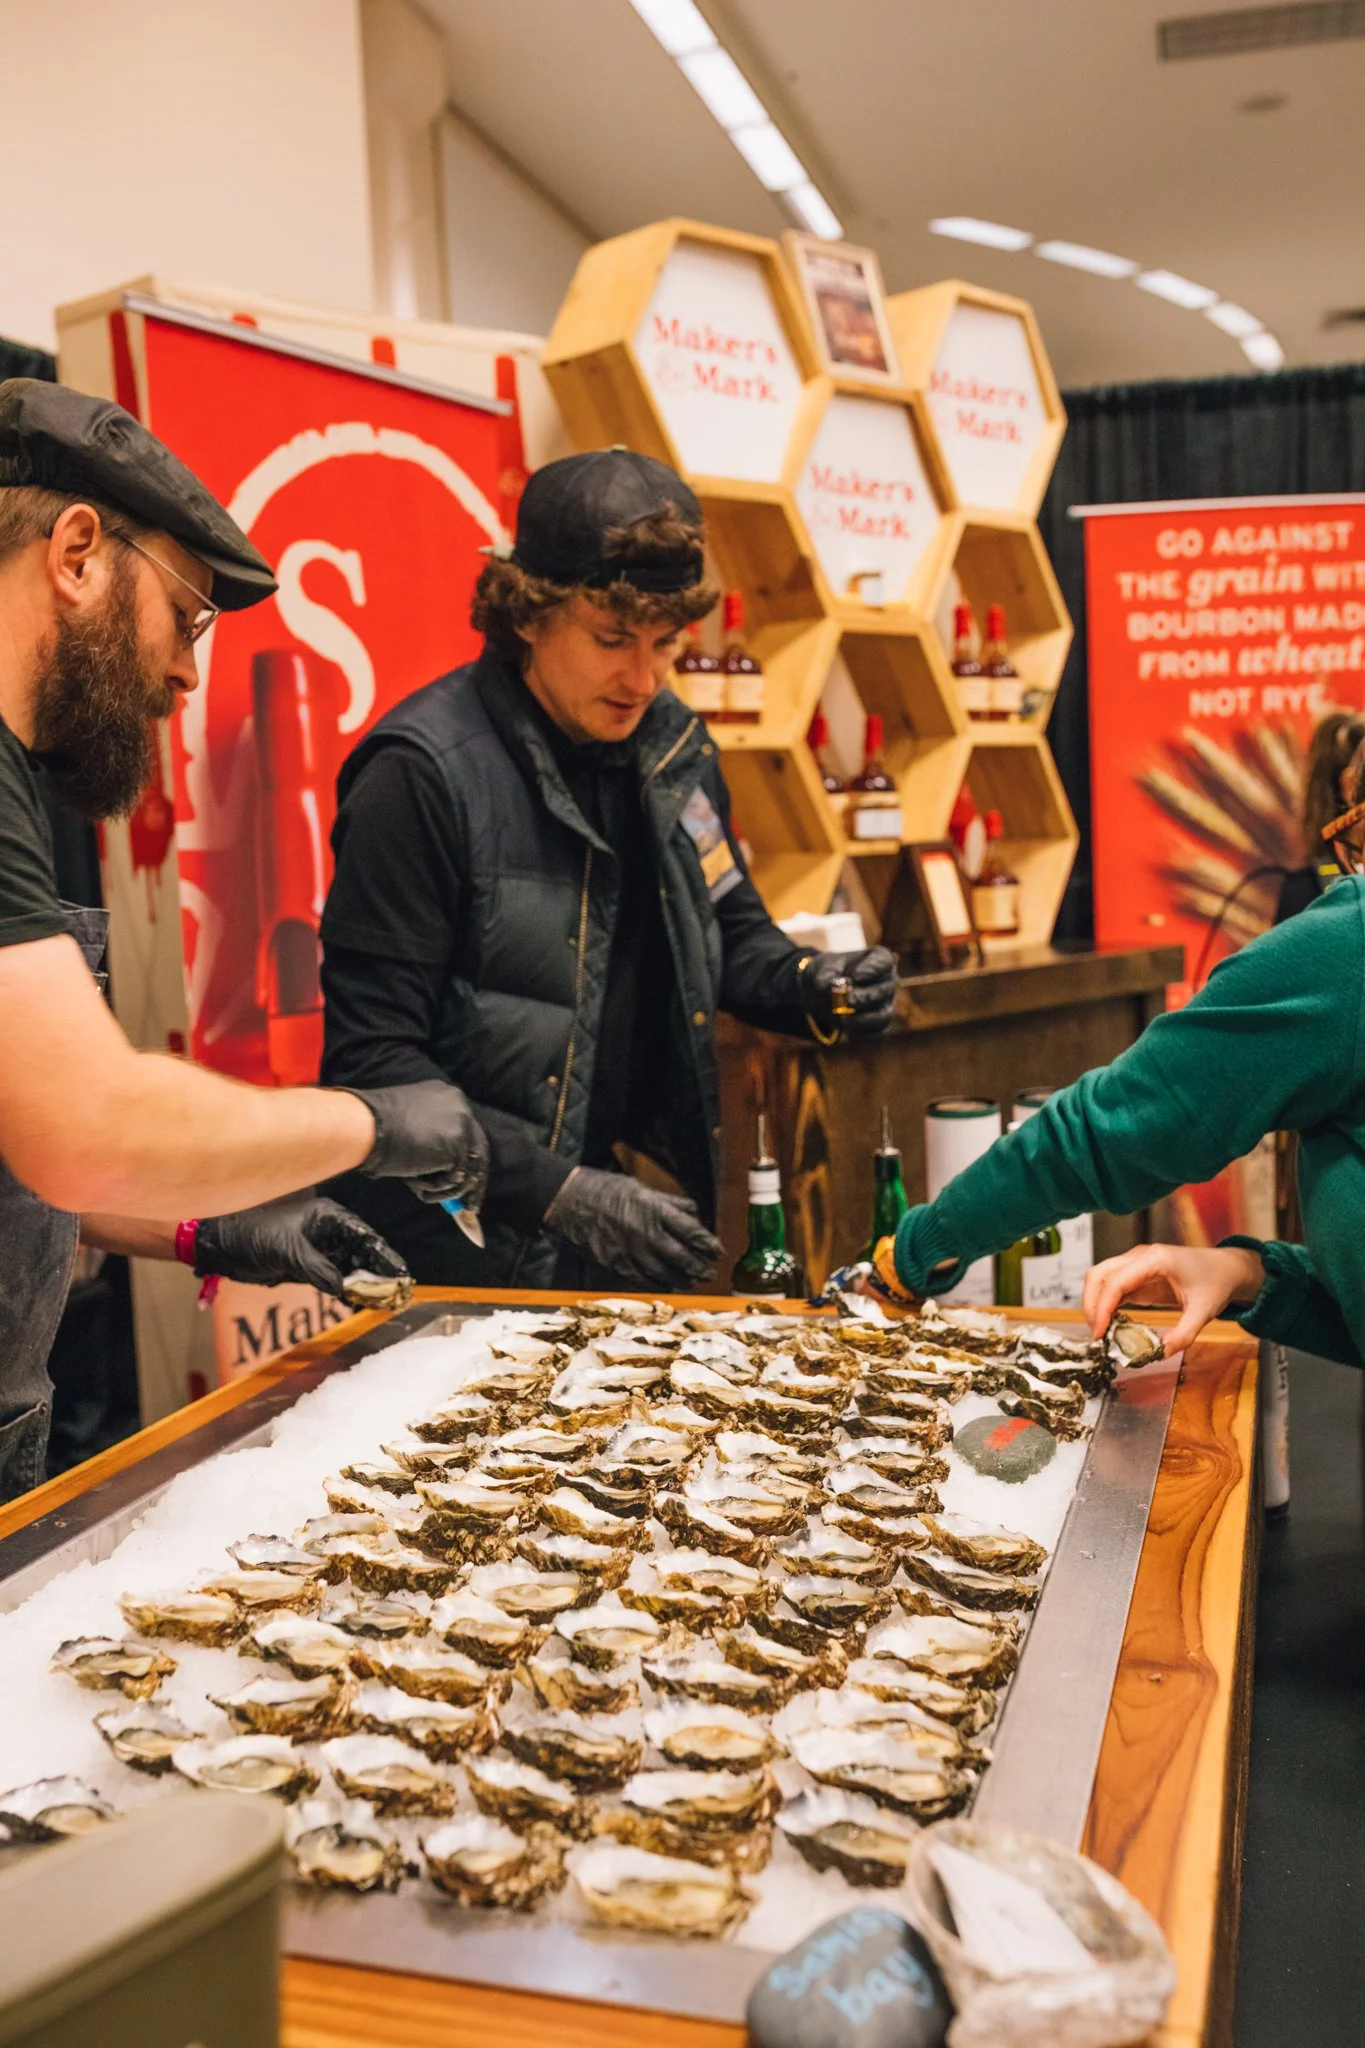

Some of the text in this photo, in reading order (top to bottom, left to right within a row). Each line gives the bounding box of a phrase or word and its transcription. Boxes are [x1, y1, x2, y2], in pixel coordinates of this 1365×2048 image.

[1156, 521, 1353, 559] GO AGAINST
[1115, 569, 1181, 600] THE
[1186, 553, 1304, 608] grain
[1126, 605, 1286, 642] BOURBON
[1138, 647, 1230, 681] FROM
[1188, 687, 1253, 717] NOT
[820, 1946, 935, 2026] bay
